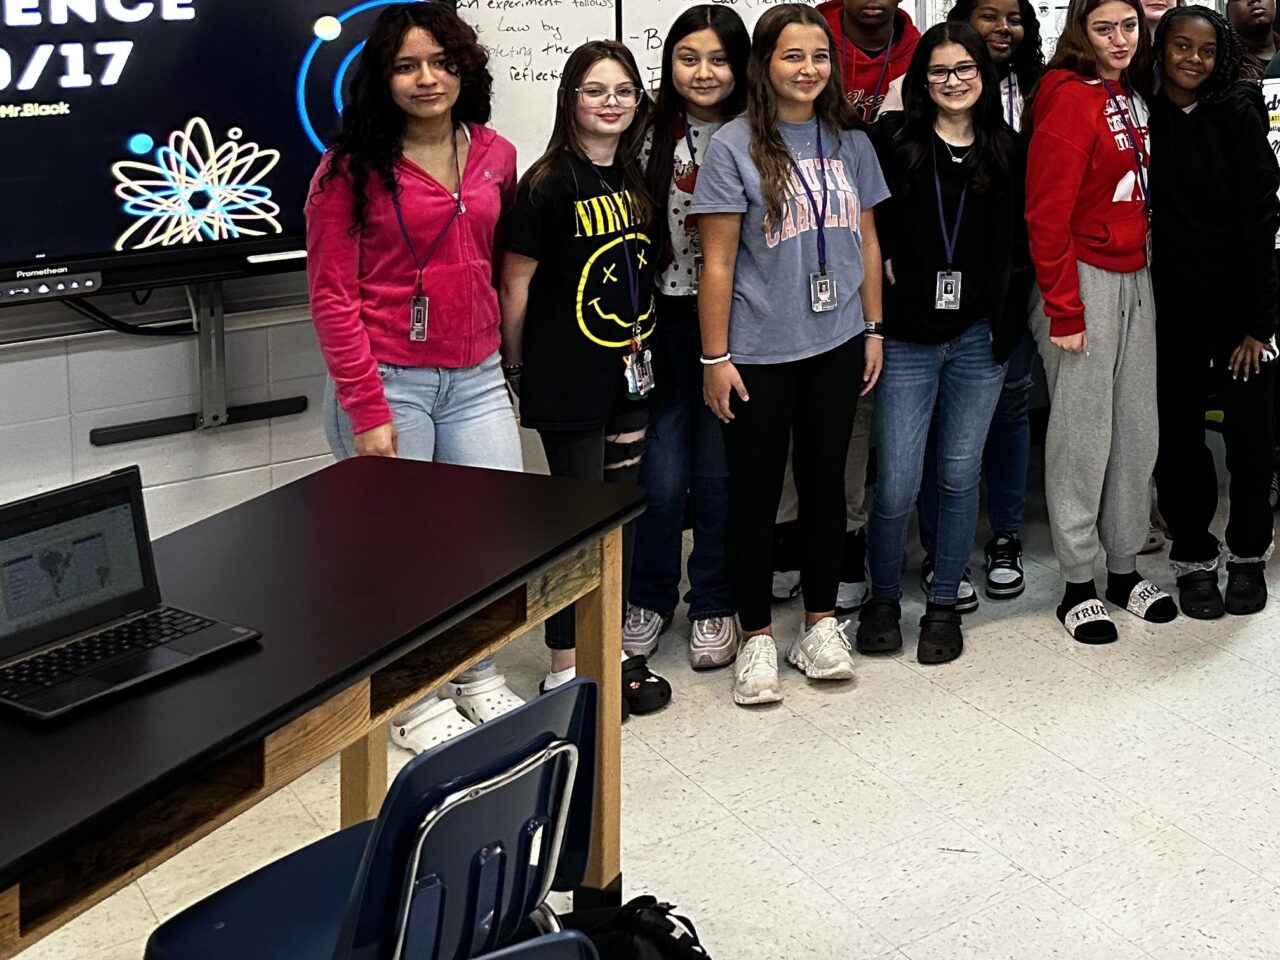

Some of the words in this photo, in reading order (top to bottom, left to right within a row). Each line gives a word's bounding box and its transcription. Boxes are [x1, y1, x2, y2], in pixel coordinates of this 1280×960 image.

[541, 19, 563, 41] by
[484, 43, 533, 67] pleting
[541, 42, 573, 55] the
[0, 101, 71, 119] Mr.Black
[573, 189, 642, 237] NIRV
[16, 266, 68, 279] Promethean
[1073, 604, 1107, 622] TRUE
